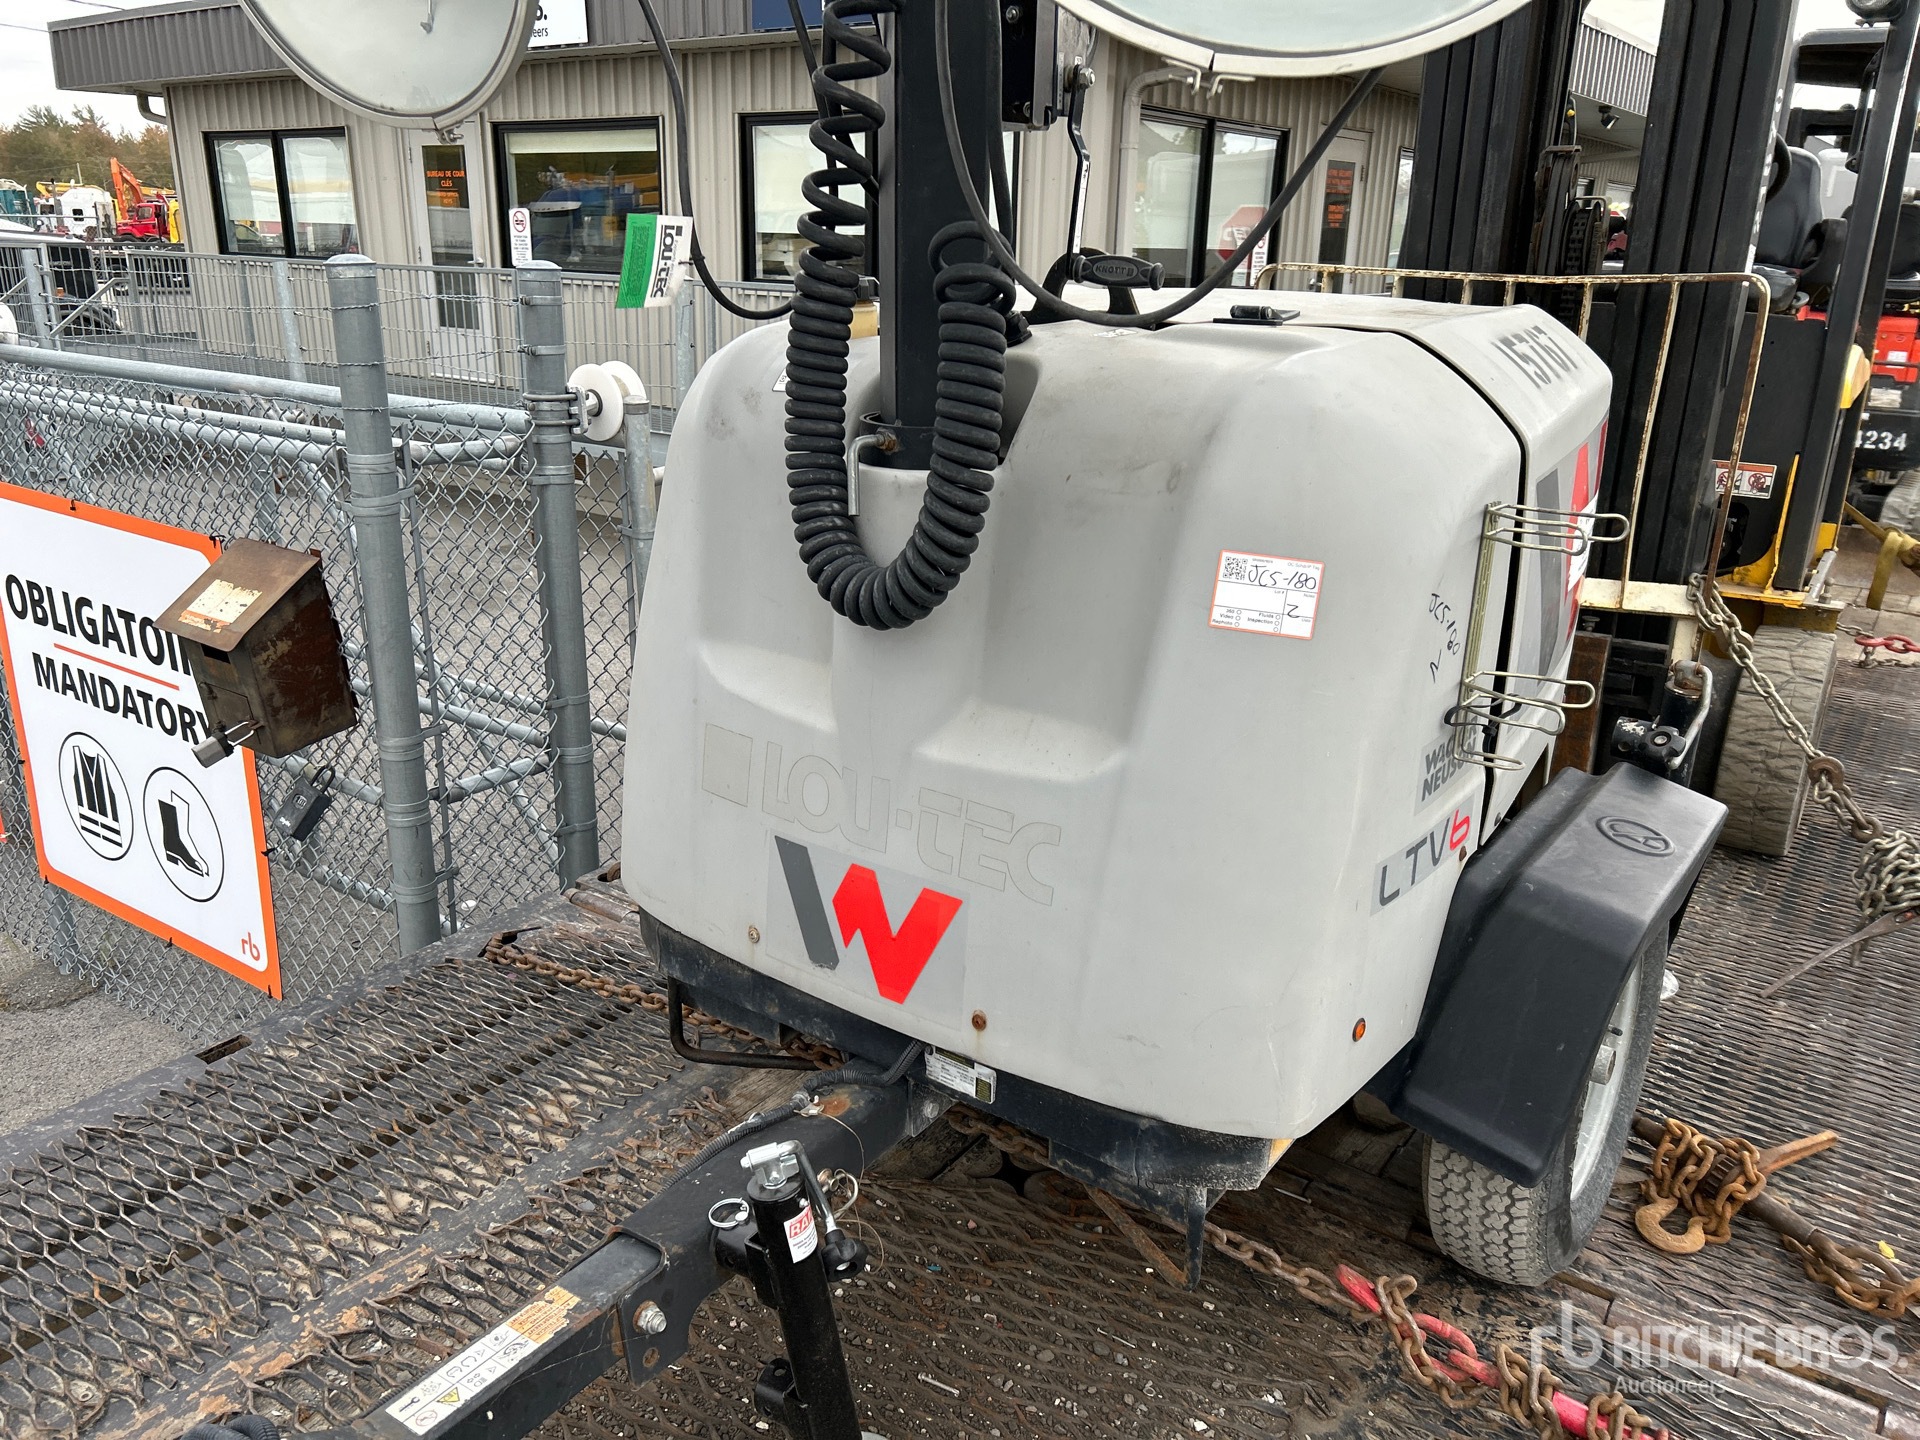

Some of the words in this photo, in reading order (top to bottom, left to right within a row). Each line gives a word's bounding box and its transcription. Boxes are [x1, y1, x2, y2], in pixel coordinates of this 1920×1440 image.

[653, 225, 675, 298] LOU-TEC
[1095, 265, 1127, 275] KNOTT
[1425, 715, 1478, 775] WACR
[761, 741, 1062, 907] LOU-TEC
[241, 931, 261, 962] rb
[789, 1207, 814, 1239] RA
